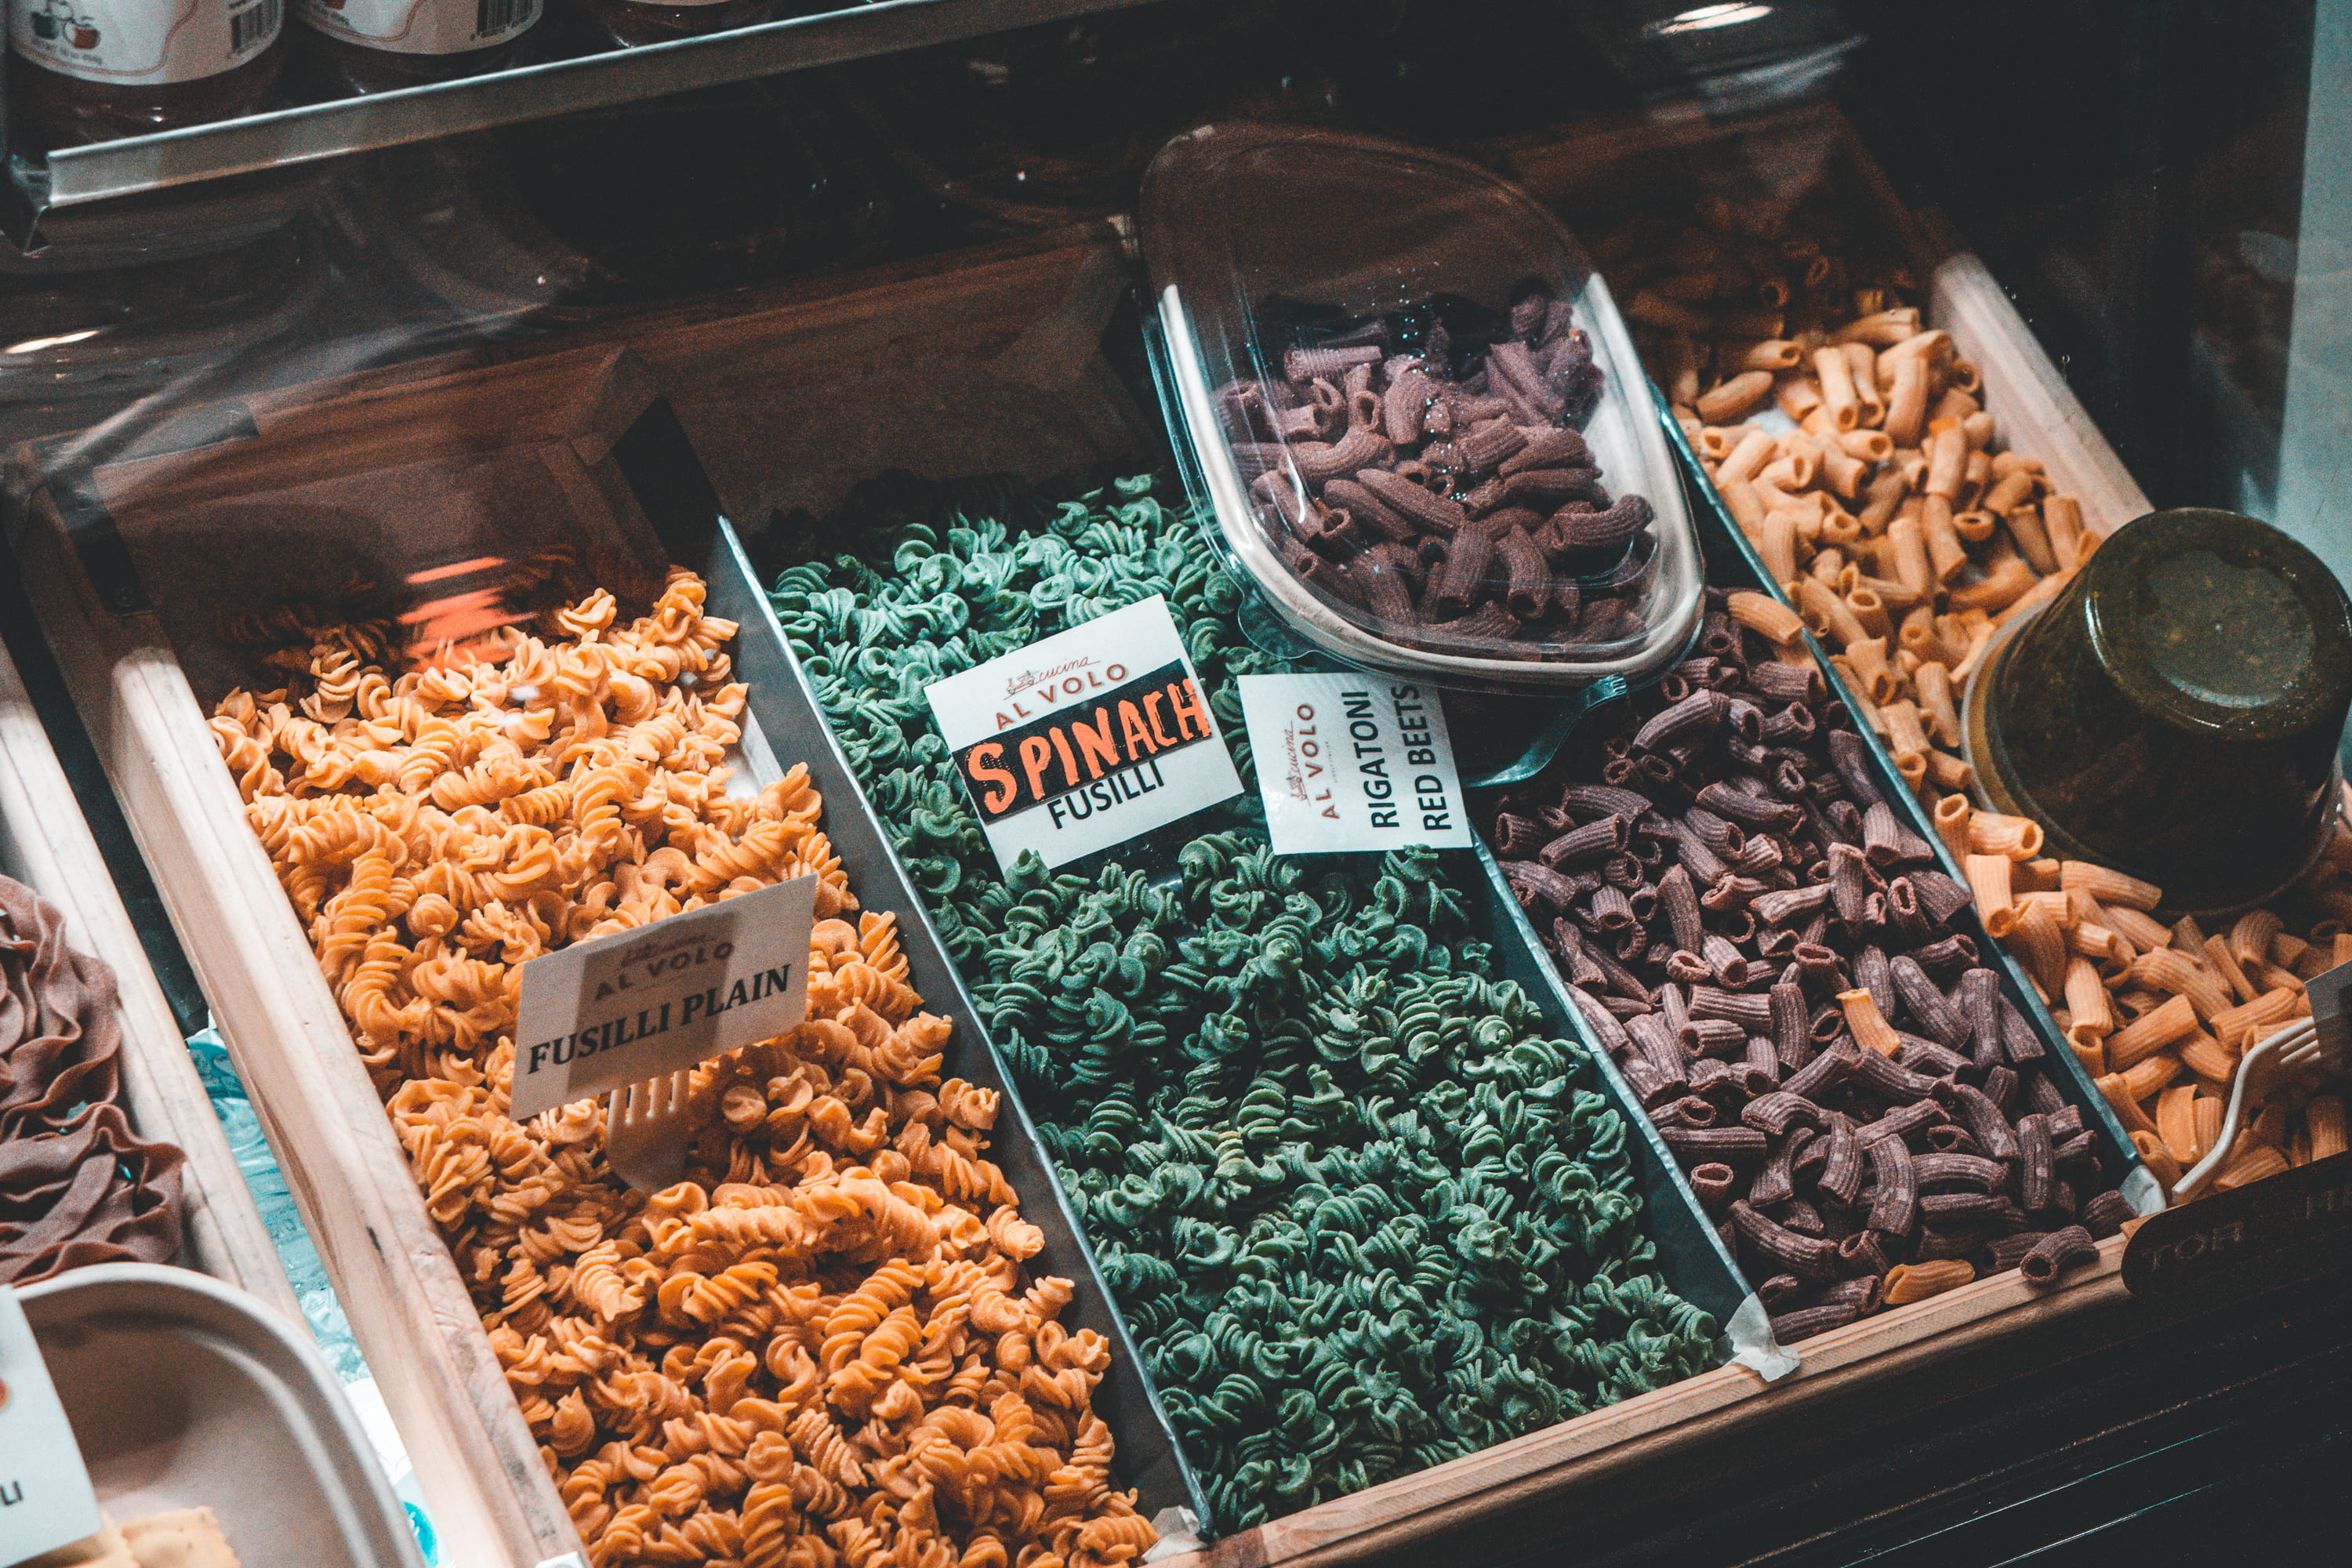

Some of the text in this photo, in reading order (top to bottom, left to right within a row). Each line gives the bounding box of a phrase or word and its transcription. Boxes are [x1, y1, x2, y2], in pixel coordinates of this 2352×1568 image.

[995, 663, 1127, 731] AL VOLO
[1039, 656, 1101, 682] cucina
[967, 677, 1212, 815] SPINACH
[1297, 702, 1323, 778] VOLO
[1341, 691, 1399, 828] RIGATONI
[1391, 685, 1452, 830] RED BEETS
[1047, 760, 1165, 829] FUSILLI
[1316, 789, 1340, 819] AL
[594, 974, 634, 1000] AL
[647, 942, 735, 978] VOLO
[528, 964, 792, 1075] FUSILLI PLAIN
